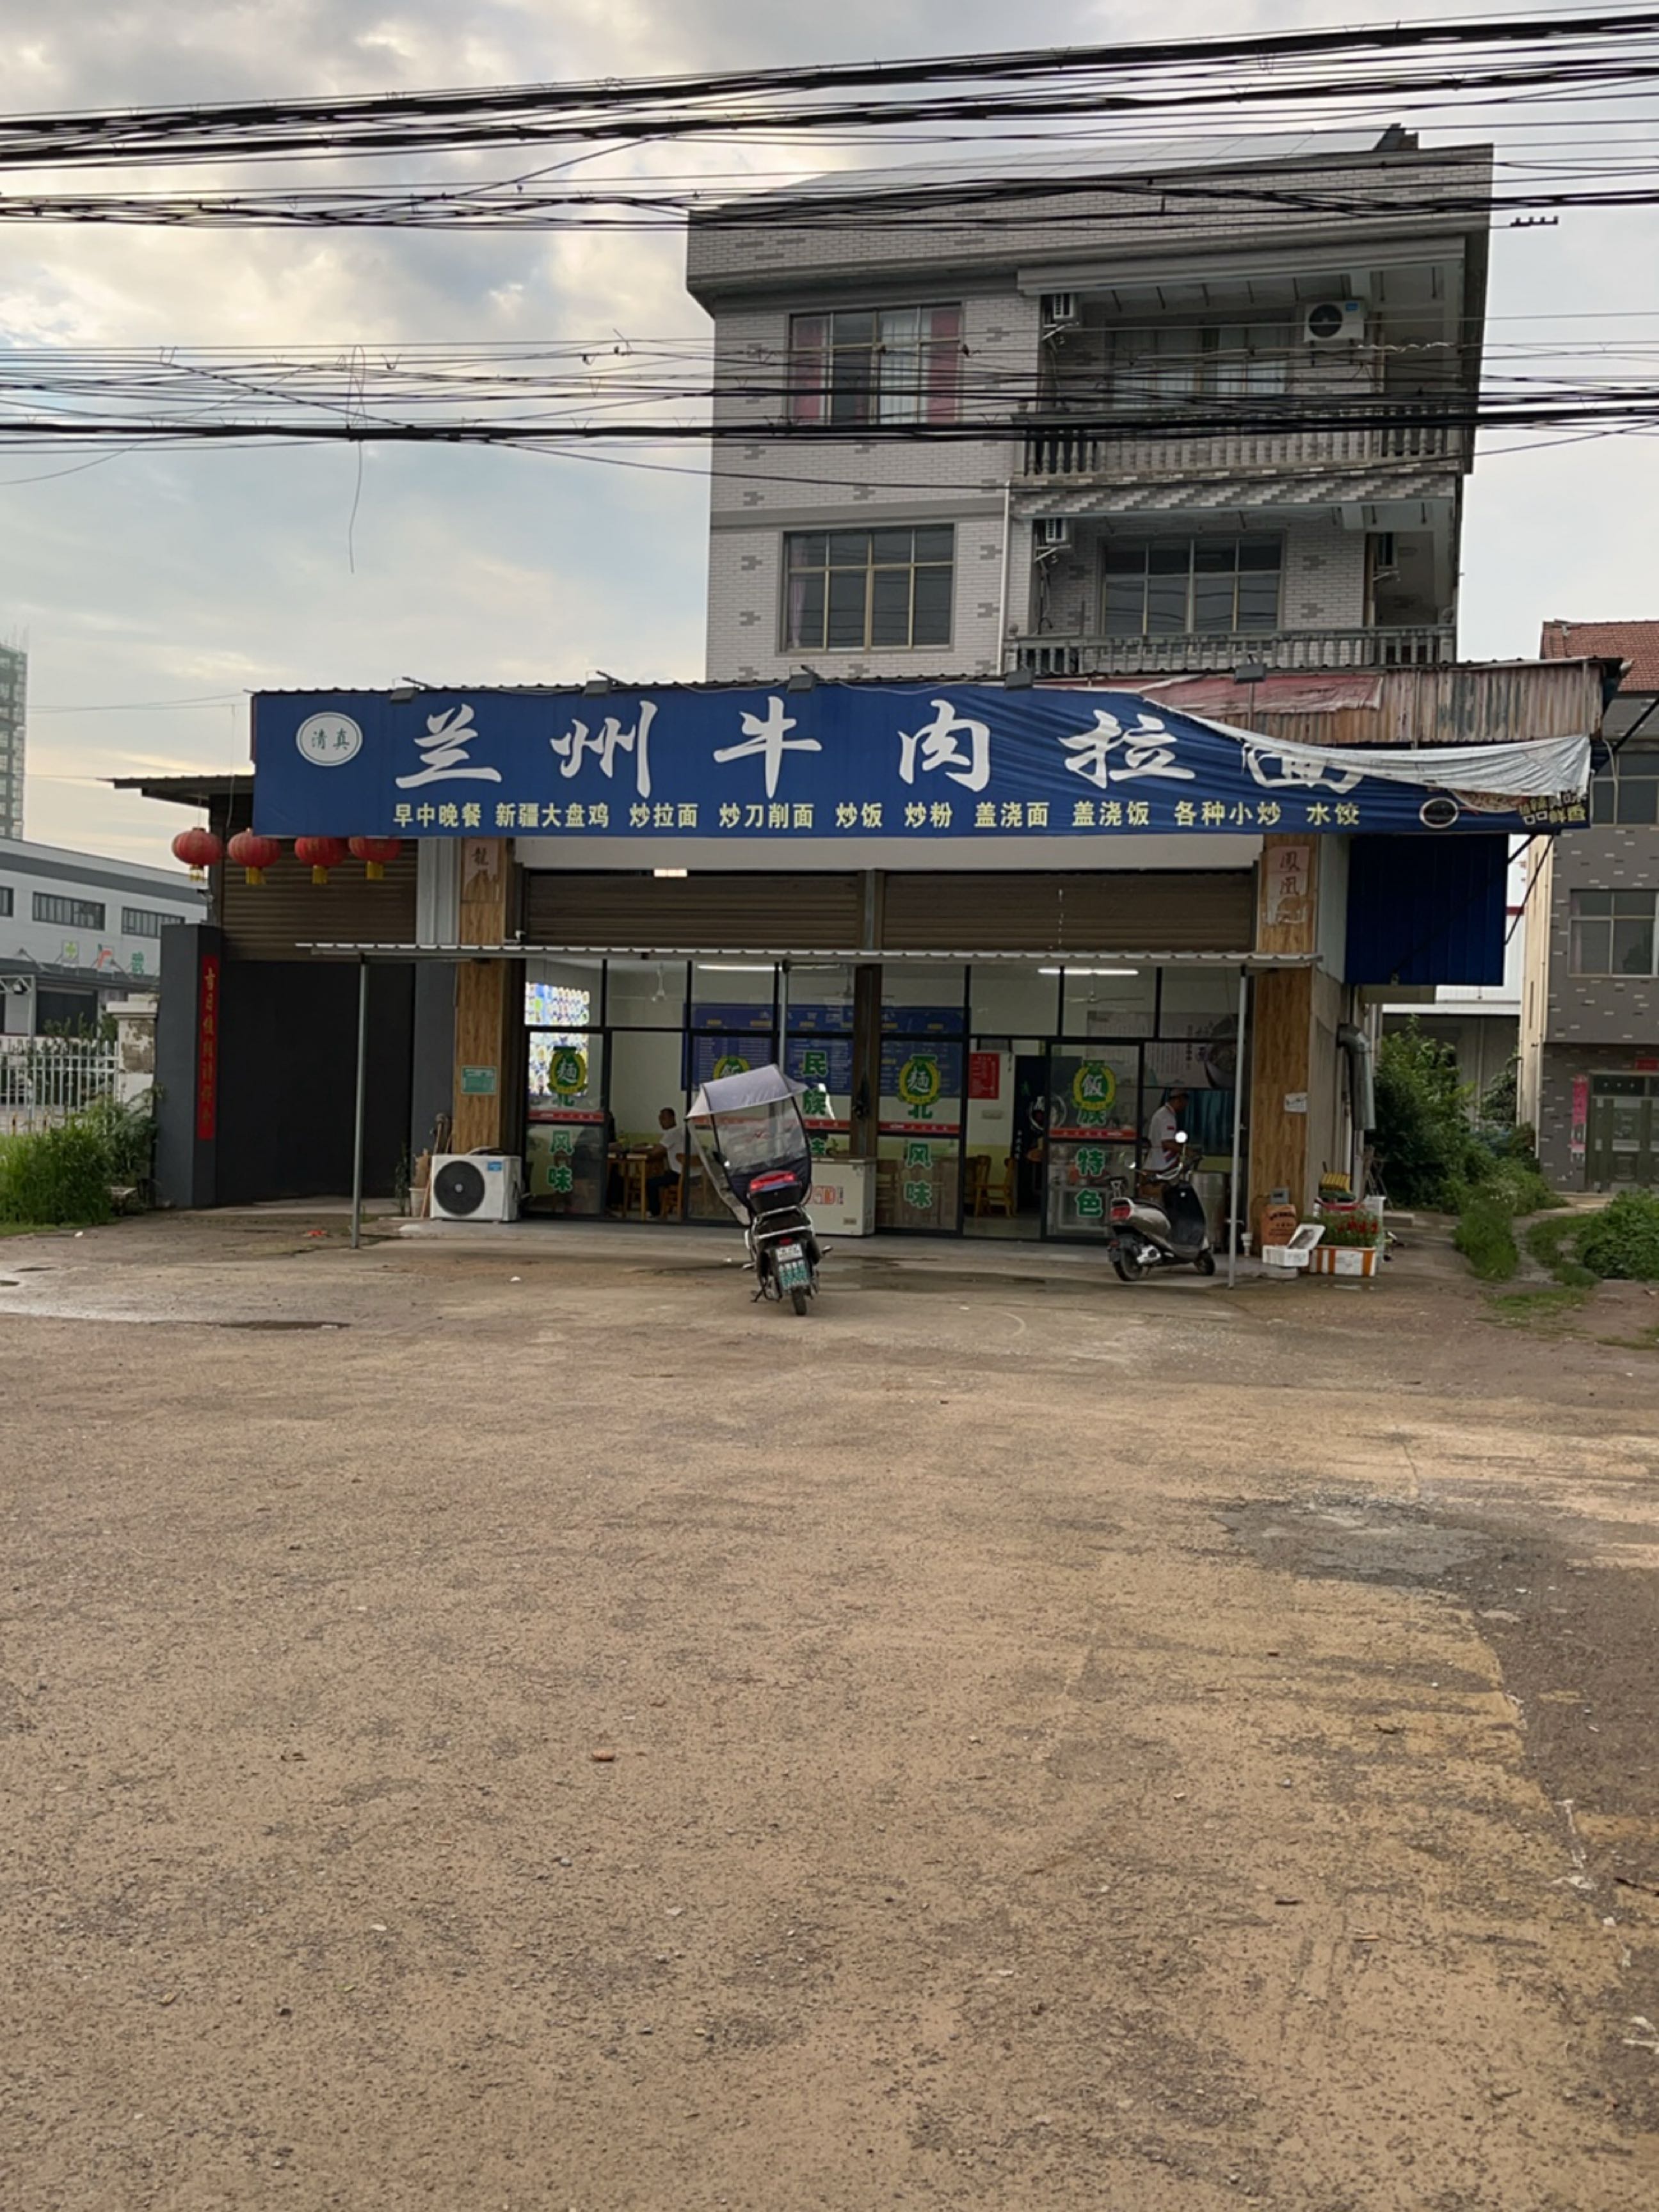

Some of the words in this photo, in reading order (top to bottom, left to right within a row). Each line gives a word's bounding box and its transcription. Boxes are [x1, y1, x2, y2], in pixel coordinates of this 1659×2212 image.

[311, 728, 350, 750] 清真
[394, 803, 481, 828] 早中晚餐
[496, 803, 609, 828] 新疆大盘鸡
[629, 802, 698, 828] 炒拉面
[719, 803, 813, 829] 炒刀削面
[836, 802, 882, 829] 炒饭
[904, 801, 952, 828] 炒粉
[974, 801, 1050, 828] 盖浇面
[1072, 801, 1149, 826] 盖浇饭
[1174, 801, 1281, 826] 各种小炒
[1306, 803, 1359, 826] 水饺
